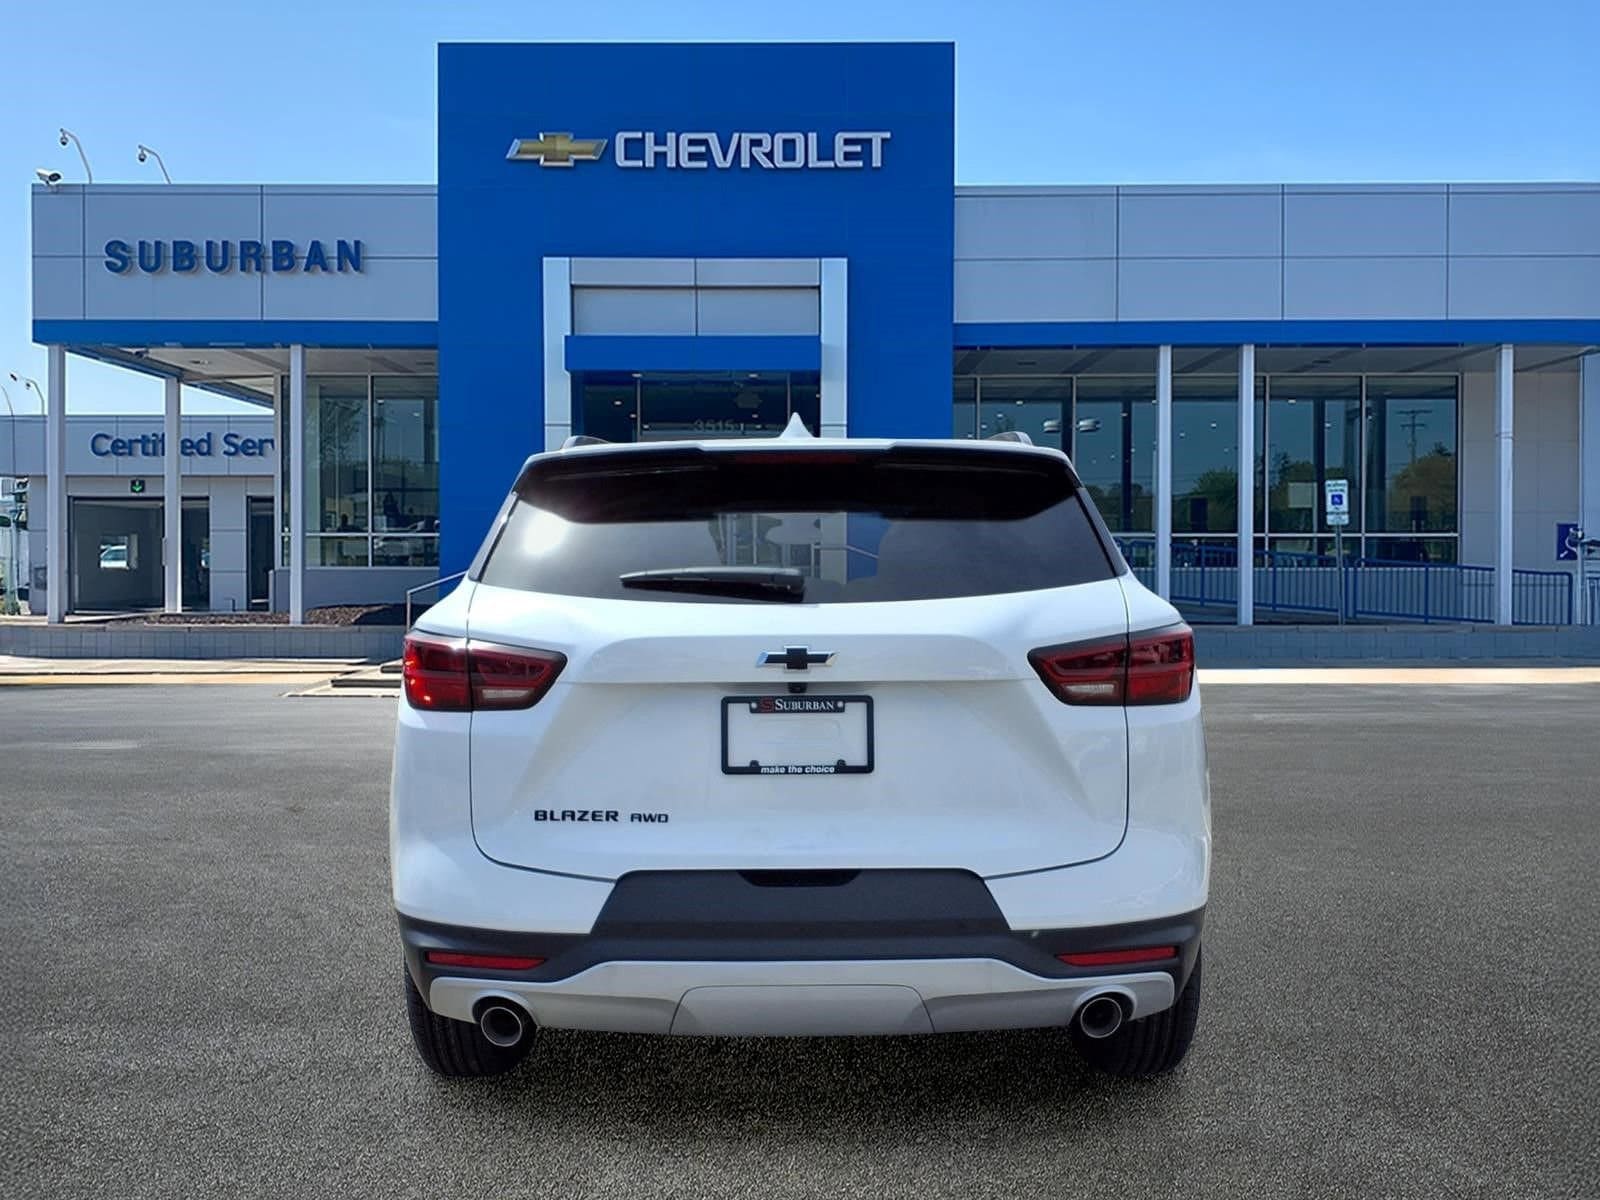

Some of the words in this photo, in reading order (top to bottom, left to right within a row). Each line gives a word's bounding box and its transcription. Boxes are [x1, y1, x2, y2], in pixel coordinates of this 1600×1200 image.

[615, 131, 891, 168] CHEVROLET
[104, 240, 362, 274] SUBURBAN
[90, 432, 212, 456] Certifed
[761, 767, 785, 775] make
[788, 766, 802, 775] the
[805, 766, 835, 775] choice
[534, 810, 619, 822] BLAZER
[630, 813, 669, 823] AWD
